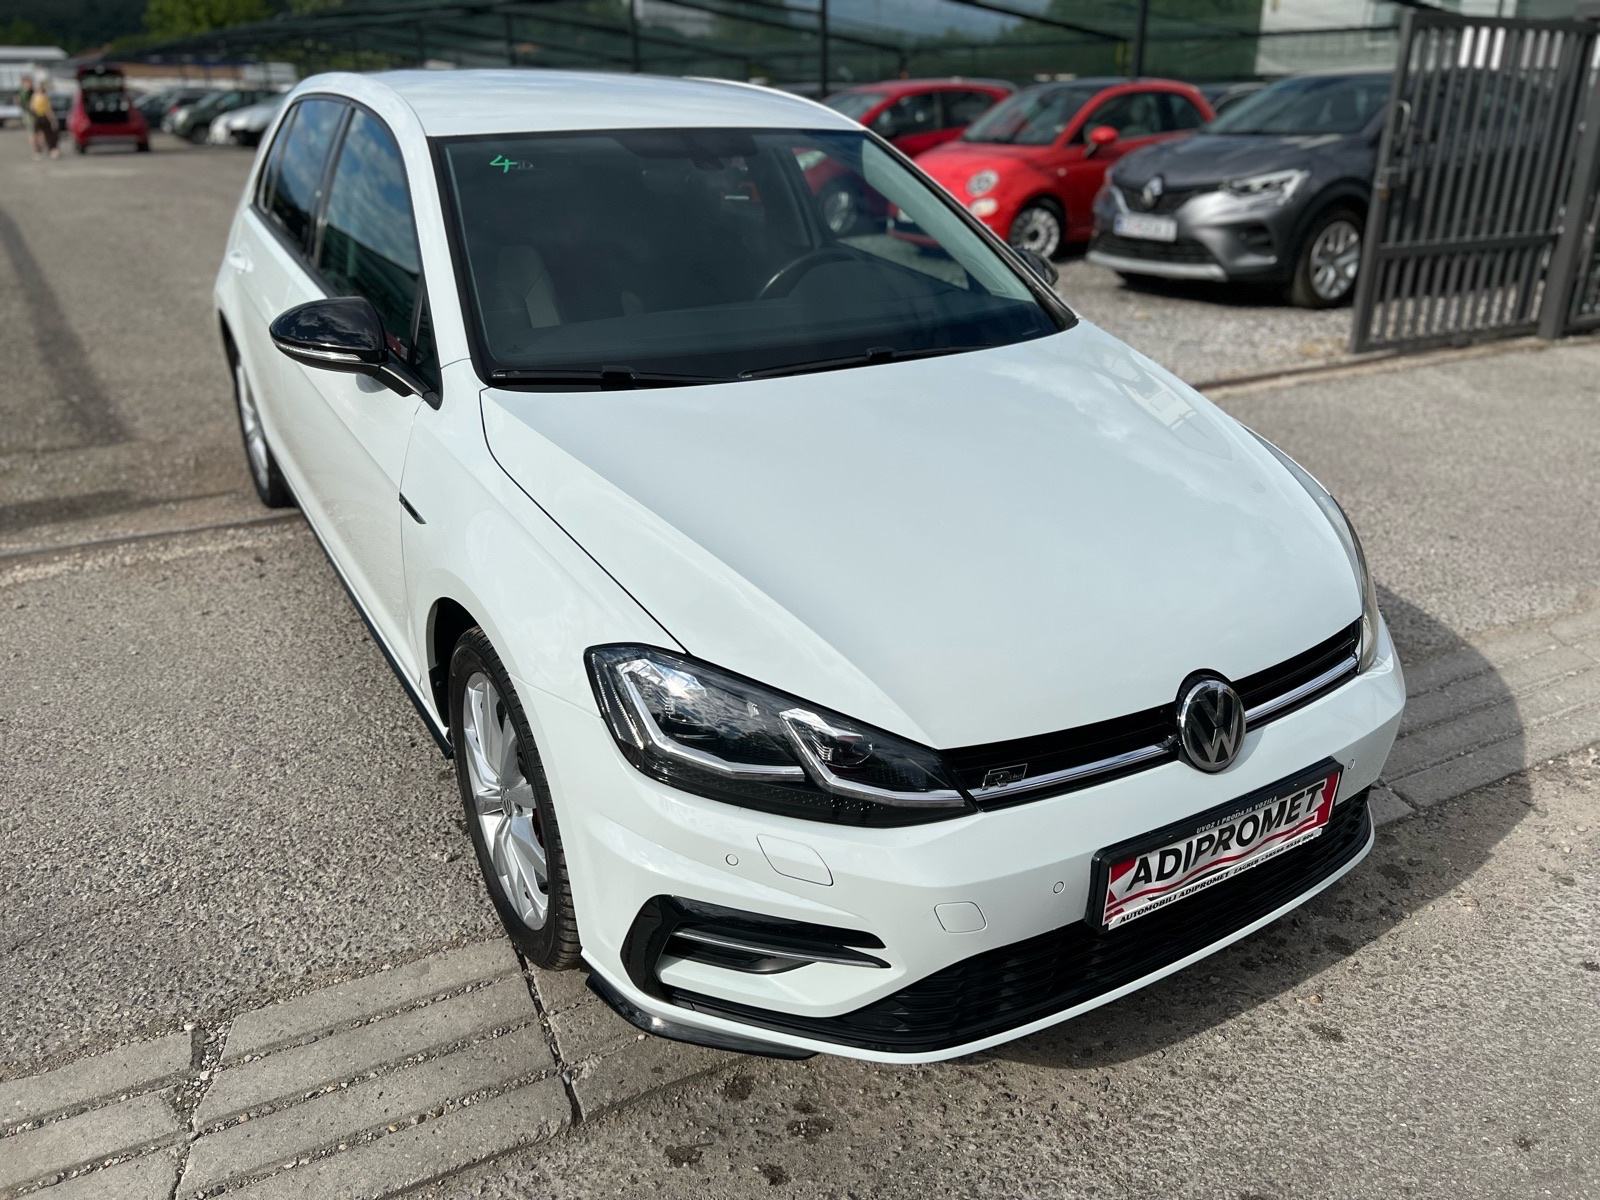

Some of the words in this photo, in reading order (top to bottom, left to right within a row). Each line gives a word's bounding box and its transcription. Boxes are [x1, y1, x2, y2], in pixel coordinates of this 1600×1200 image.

[489, 154, 518, 173] 4
[1125, 781, 1325, 892] ADIPROMET
[1119, 894, 1177, 923] AUTOMOBILI
[1178, 871, 1230, 898] ADIPROMET
